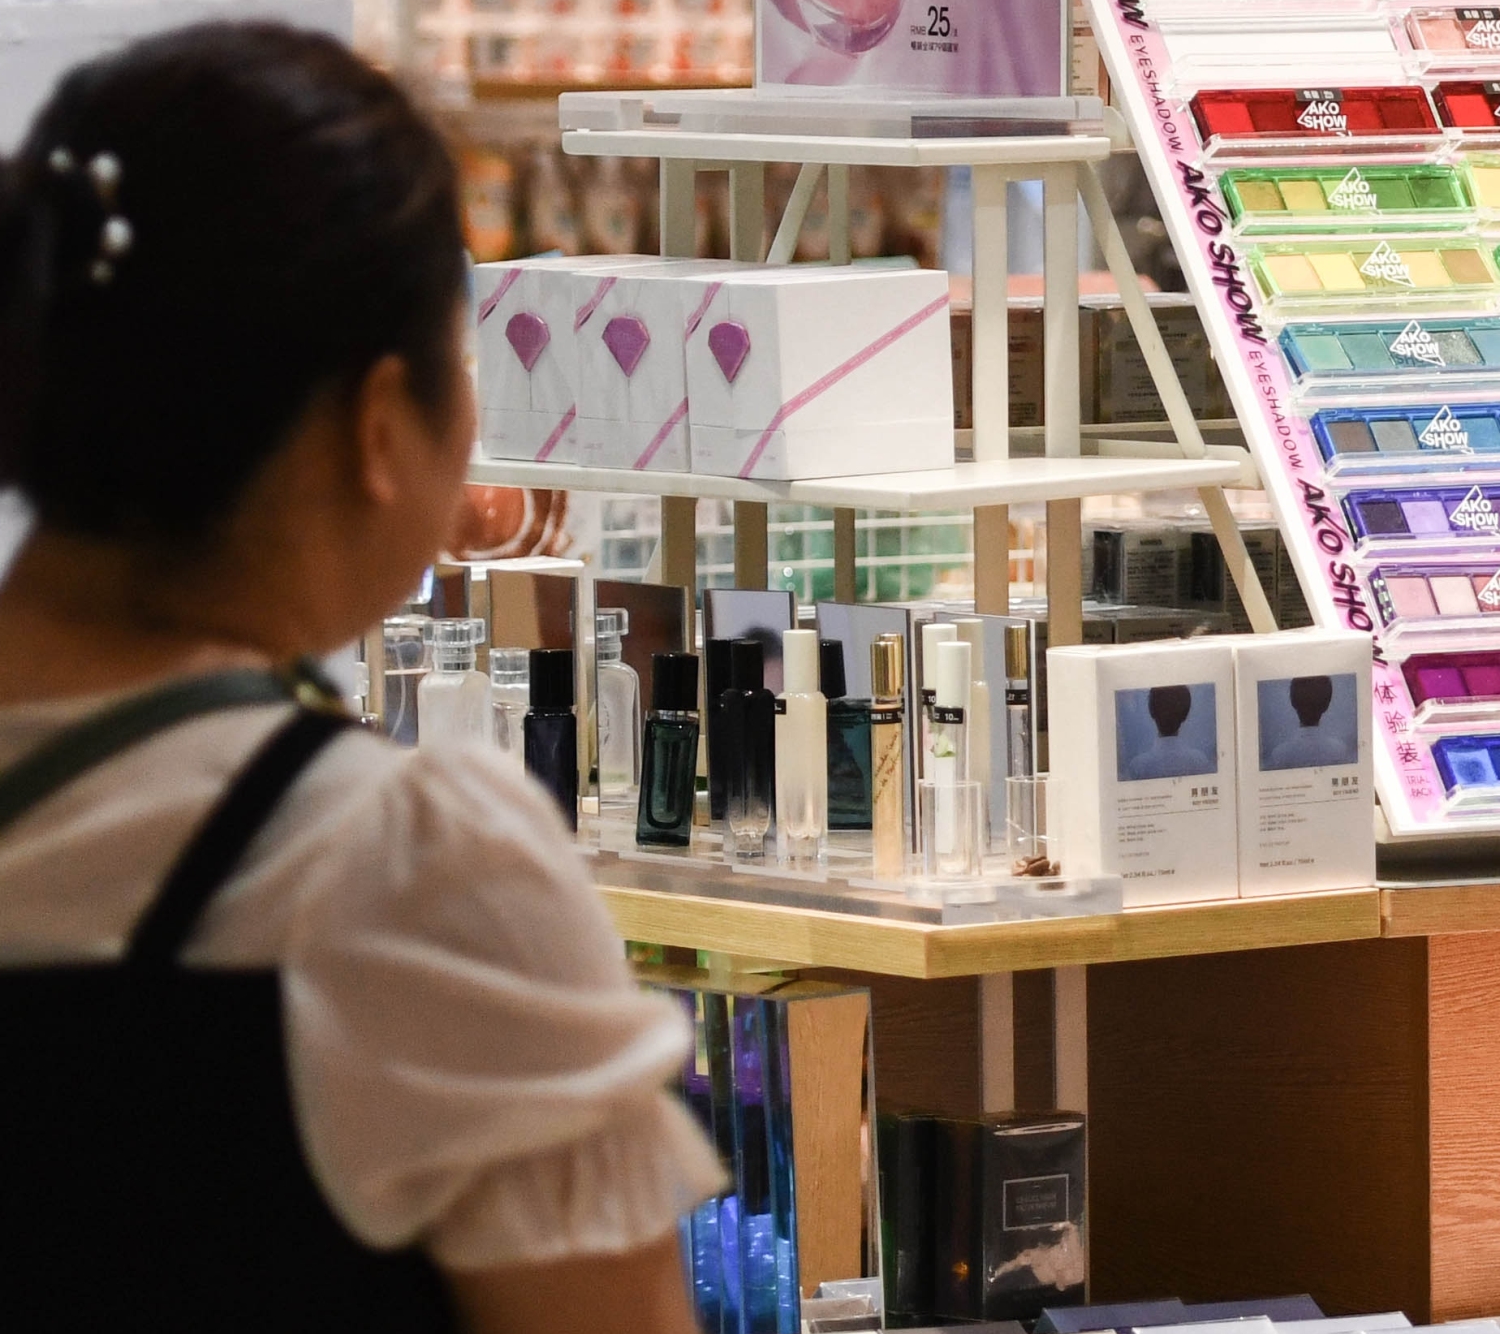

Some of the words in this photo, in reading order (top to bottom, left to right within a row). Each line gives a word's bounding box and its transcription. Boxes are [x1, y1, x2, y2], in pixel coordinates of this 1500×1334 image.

[1129, 34, 1185, 154] EYESHADOW
[1308, 101, 1341, 116] AKO
[1303, 114, 1348, 130] SHOW
[1338, 180, 1370, 195] AKO
[1333, 193, 1378, 208] SHOW
[1177, 159, 1229, 236] AKO
[1208, 240, 1268, 346] SHOW
[1247, 349, 1304, 471] EYESHADOW
[1429, 418, 1462, 432] AKO
[1425, 430, 1469, 445] SHOW
[1460, 499, 1492, 513] AKO
[1297, 477, 1347, 556] AKO
[1456, 511, 1500, 526] SHOW
[1373, 681, 1422, 764] 体验装
